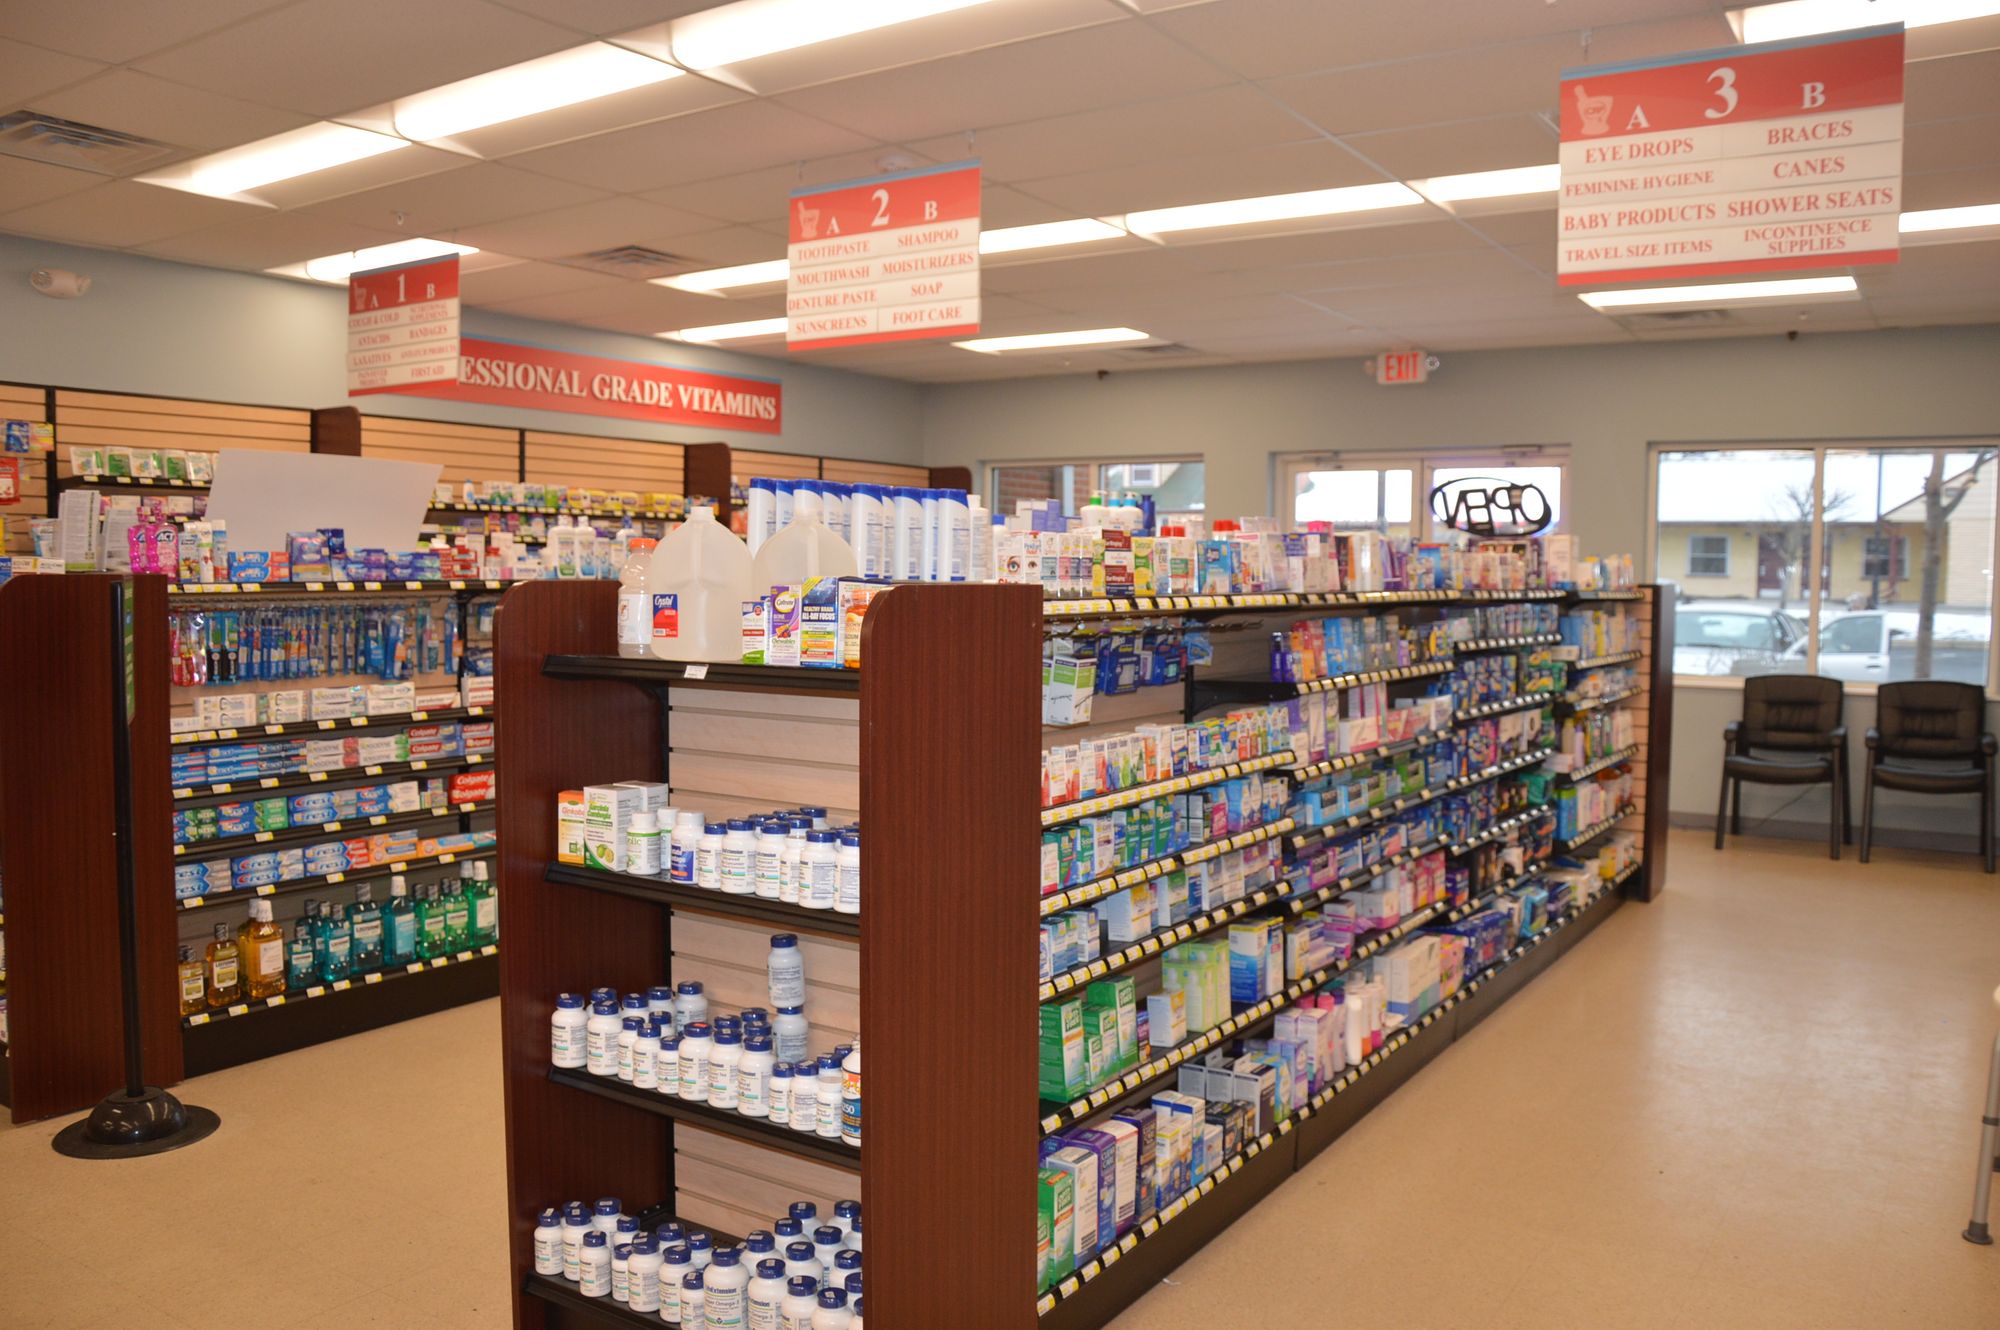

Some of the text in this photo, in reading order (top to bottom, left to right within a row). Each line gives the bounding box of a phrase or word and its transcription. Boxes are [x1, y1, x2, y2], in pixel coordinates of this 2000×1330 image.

[1626, 104, 1650, 130] A
[1704, 67, 1739, 120] 3
[1800, 82, 1826, 110] B
[1767, 120, 1853, 145] BRACES
[1585, 137, 1694, 164] EYE DROPS
[1773, 156, 1845, 179] CANES
[1566, 170, 1714, 197] FEMININE HYGIENE
[826, 188, 938, 235] A 2 B
[1727, 187, 1893, 218] SHOWER SEATS
[1564, 203, 1717, 231] BABY PRODUCTS
[897, 228, 959, 248] SHAMPOO
[1743, 218, 1872, 243] INCONTINENCE
[798, 240, 870, 261] TOOTHPASTE
[1566, 240, 1713, 262] TRAVEL SIZE ITEMS
[1768, 236, 1846, 256] SUPPLIES
[881, 252, 974, 275] MOISTURIZERS
[796, 266, 870, 286] MOUTHWASH
[370, 273, 436, 308] A 1 B
[911, 282, 943, 296] SOAP
[788, 290, 877, 311] DENTURE PASTE
[796, 316, 867, 334] SUNSCREENS
[892, 306, 962, 325] FOOT CARE
[1385, 352, 1418, 381] EXIT
[592, 374, 673, 407] GRADE
[678, 384, 776, 421] VITAMINS
[410, 727, 438, 738] Colgate
[412, 744, 440, 753] Colgate
[457, 773, 489, 785] Colgate
[295, 795, 332, 807] Crest
[239, 856, 277, 872] Crest
[237, 871, 278, 885] Crest
